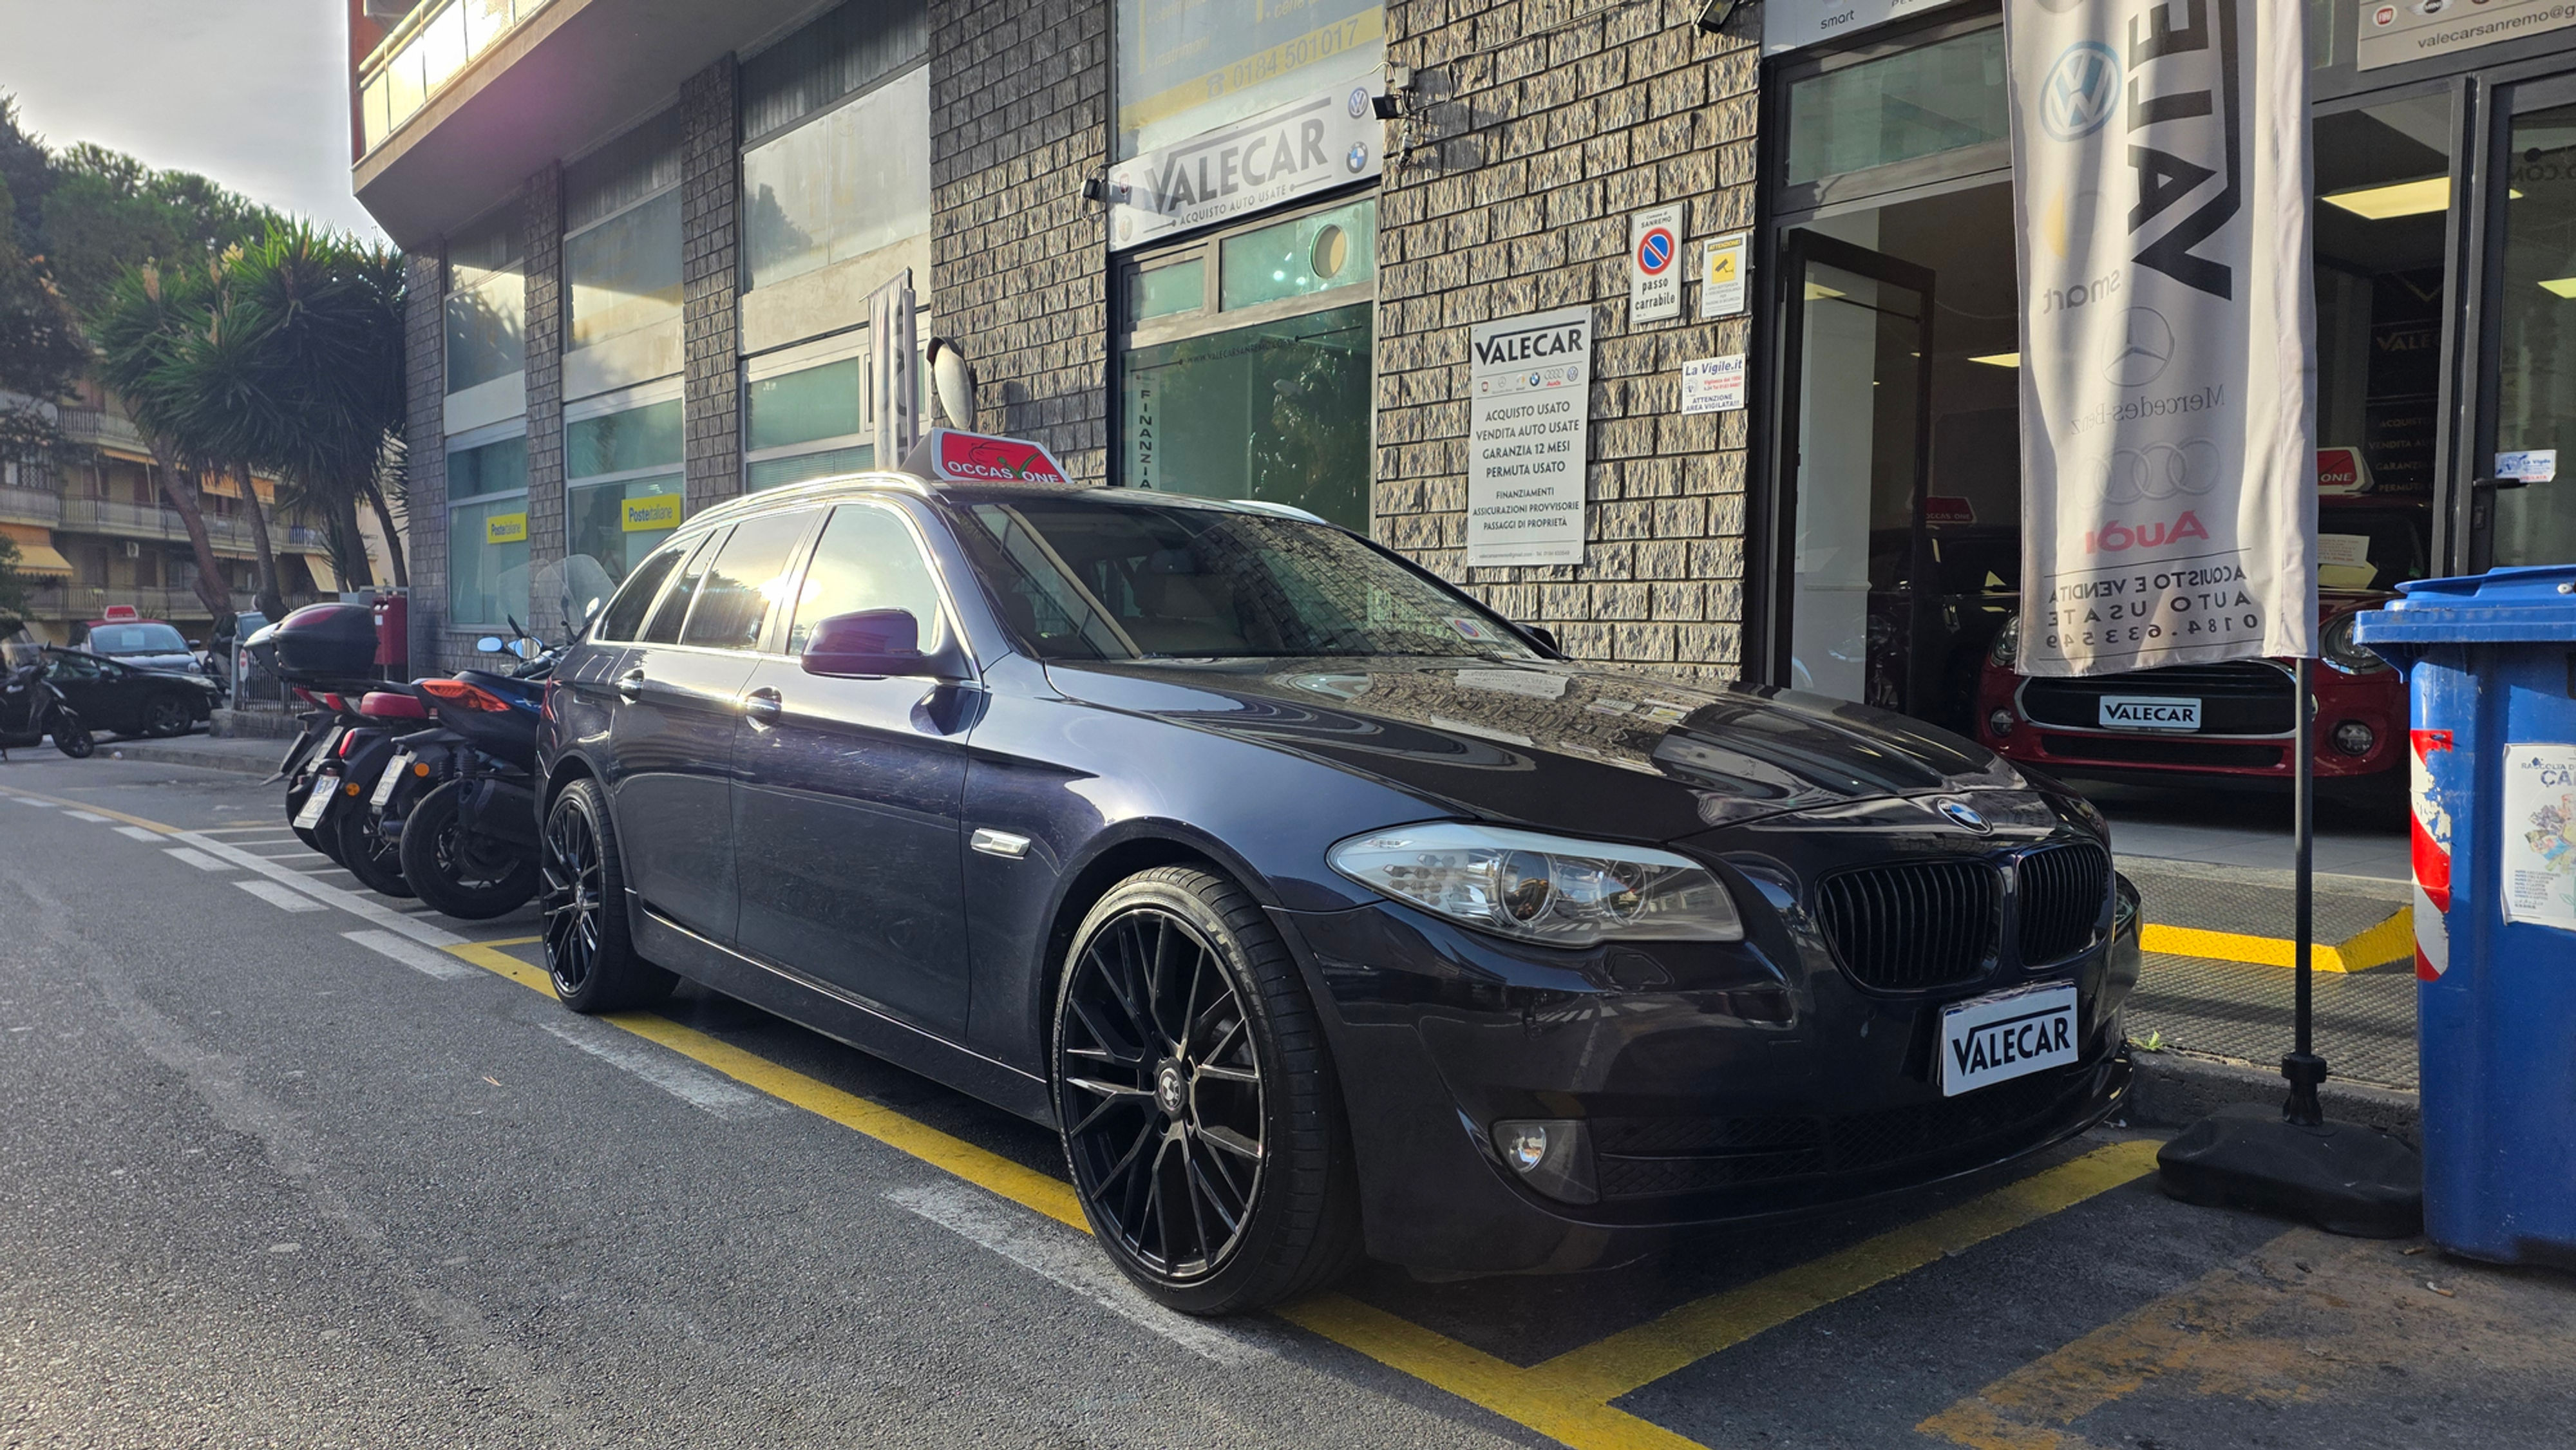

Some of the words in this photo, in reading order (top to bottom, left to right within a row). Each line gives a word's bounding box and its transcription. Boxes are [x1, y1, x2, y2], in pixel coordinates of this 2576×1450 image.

[1820, 10, 1855, 30] smart
[2418, 5, 2576, 49] valecarsanremo@g
[1233, 53, 1278, 88] 0184
[1285, 18, 1359, 69] 501017
[1144, 97, 1331, 215] VALECAR
[1180, 203, 1226, 226] ACQUISTO
[1230, 194, 1255, 212] AUTO
[1258, 184, 1287, 203] USATE
[1641, 216, 1672, 229] SANREMO
[1642, 278, 1669, 295] passo
[1634, 292, 1675, 311] carrabile
[1475, 320, 1586, 366] VALECAR
[1685, 366, 1698, 376] La
[1701, 359, 1743, 375] Vigile.it
[1692, 393, 1733, 404] ATTENZIONE
[1485, 405, 1535, 422] ACQUISTO
[1537, 400, 1570, 415] USATO
[1139, 390, 1152, 489] FINANZIA
[1476, 427, 1516, 441] VENDITA
[1518, 423, 1546, 437] AUTO
[1549, 419, 1580, 433] USATE
[1482, 444, 1532, 460] GARANZIA
[1535, 442, 1545, 455] 12
[1547, 440, 1570, 454] MESI
[1486, 464, 1530, 478] PERMUTA
[1533, 460, 1566, 474] USATO
[1496, 487, 1554, 499] FINANZIAMENTI
[1472, 504, 1527, 516] ASSICURAZIONI
[1529, 501, 1580, 513] PROVVISORIE
[1484, 520, 1516, 530] PASSAGGI
[1518, 519, 1526, 529] DI
[1528, 516, 1567, 528] PROPRIETÀ
[2105, 702, 2197, 722] VALECAR
[1952, 1004, 2072, 1077] VALECAR
